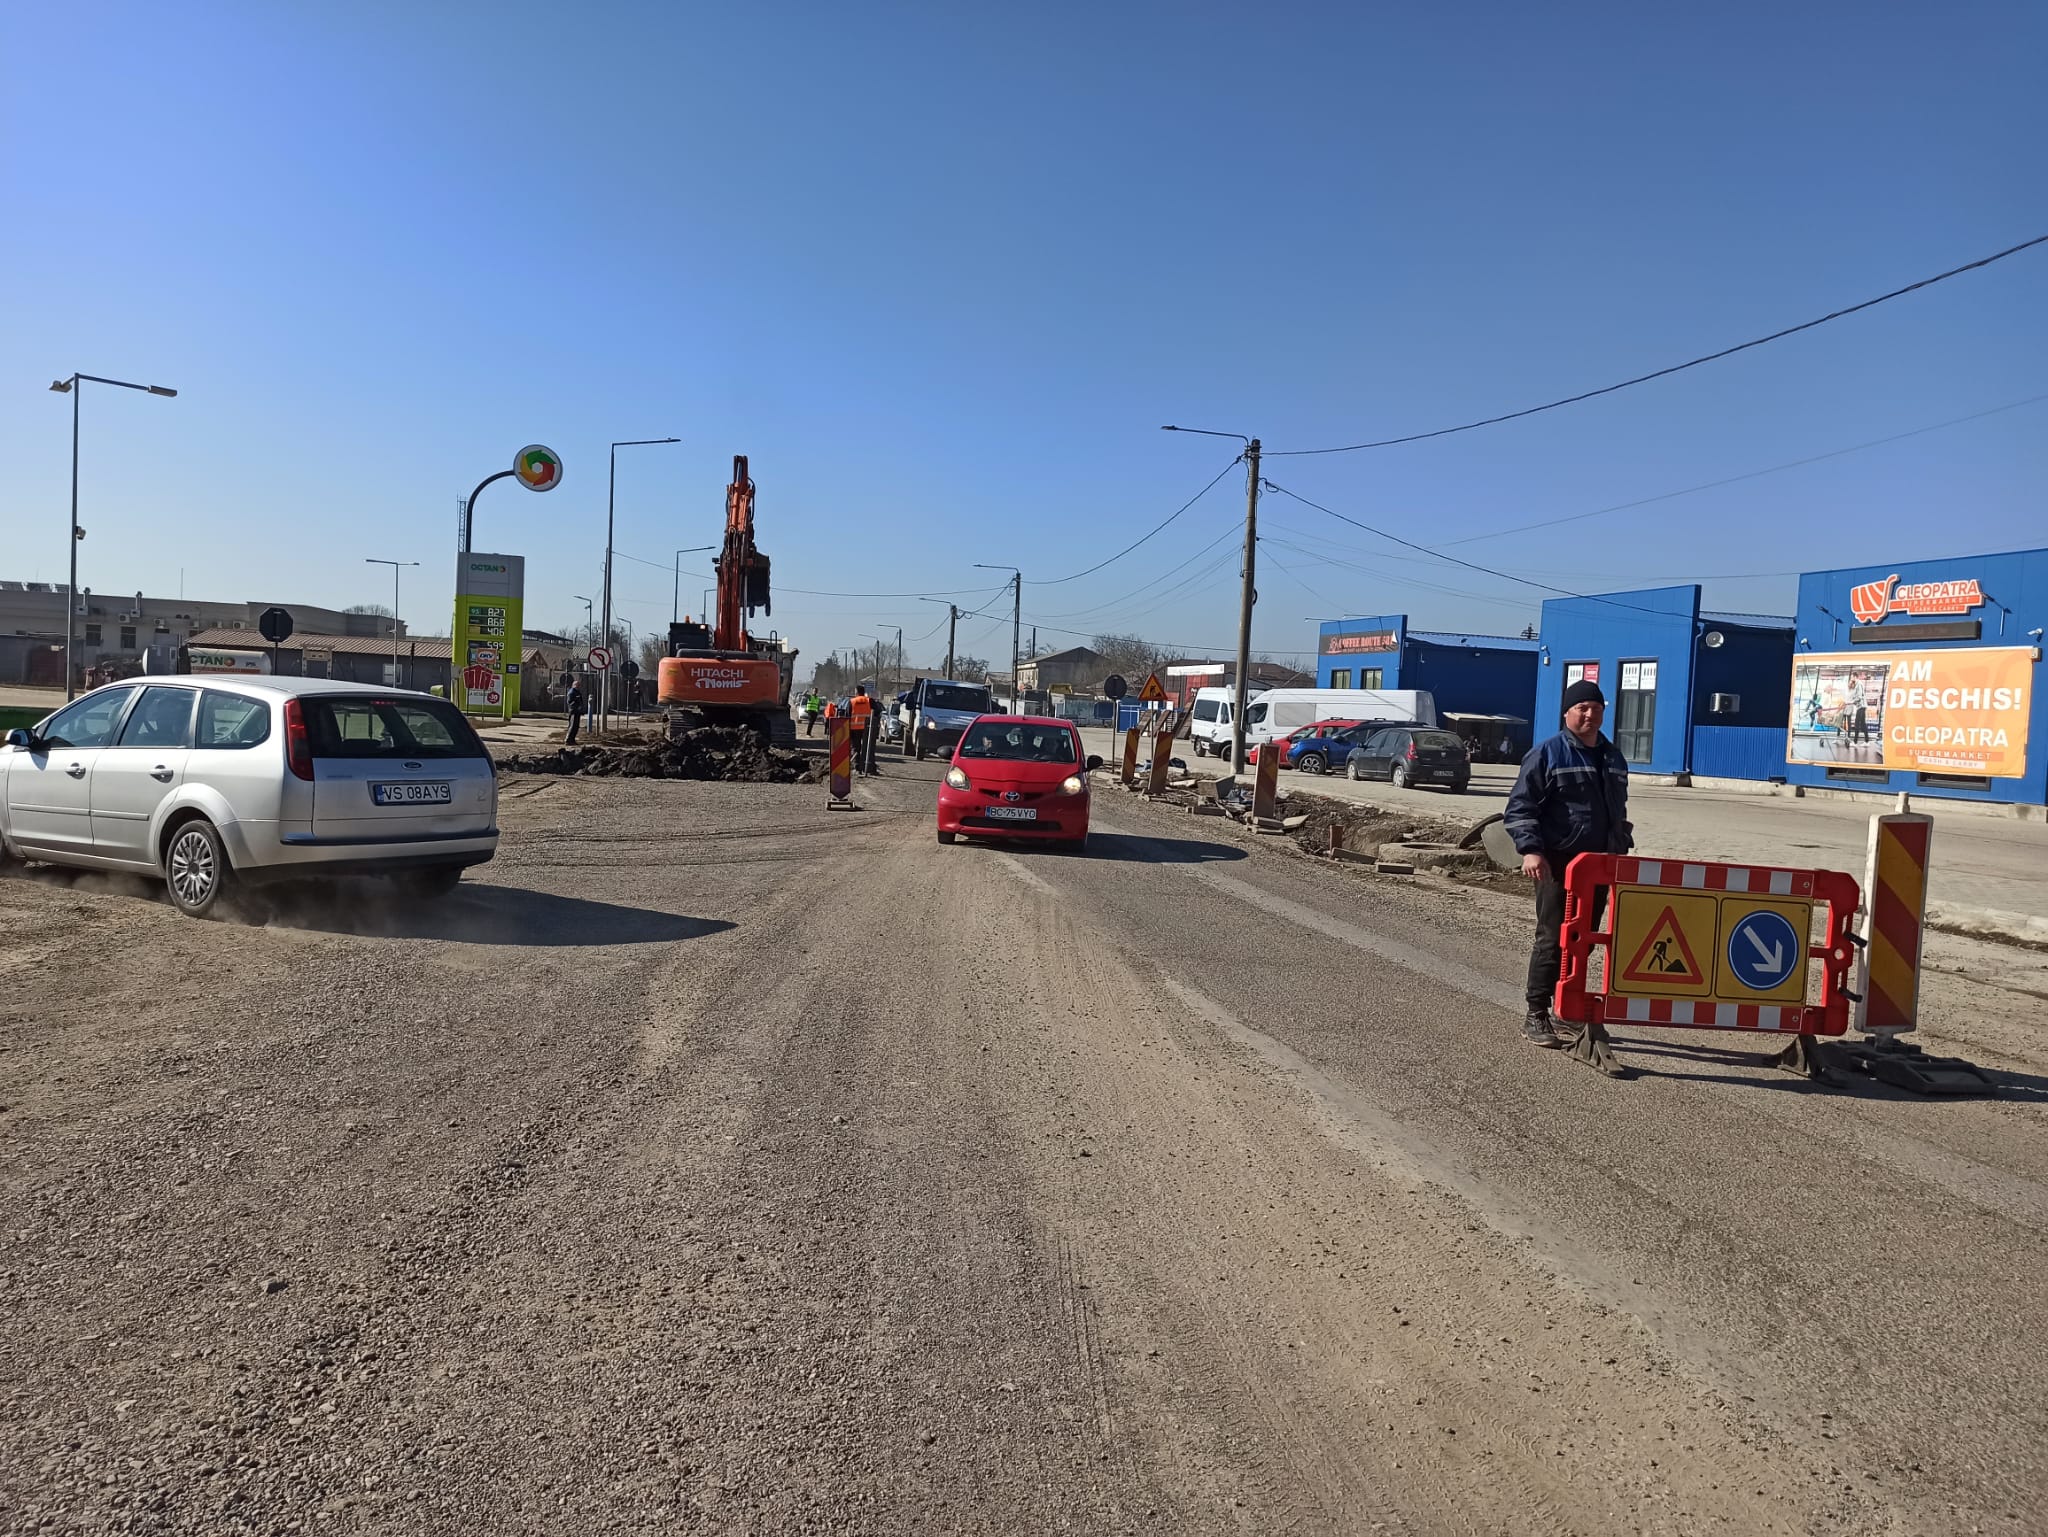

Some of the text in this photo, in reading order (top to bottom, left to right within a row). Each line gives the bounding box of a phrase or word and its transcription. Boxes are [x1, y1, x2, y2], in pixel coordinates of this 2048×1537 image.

[1896, 581, 1979, 600] CLEOPATRA
[1901, 596, 1971, 607] SUPERMARKET
[691, 668, 744, 678] HITACHI
[1891, 660, 1933, 682] AM
[1890, 687, 2022, 711] DESCHIS!
[1891, 725, 2009, 748] CLEOPATRA
[1908, 748, 1992, 761] SUPERMARKET
[384, 786, 403, 800] VS
